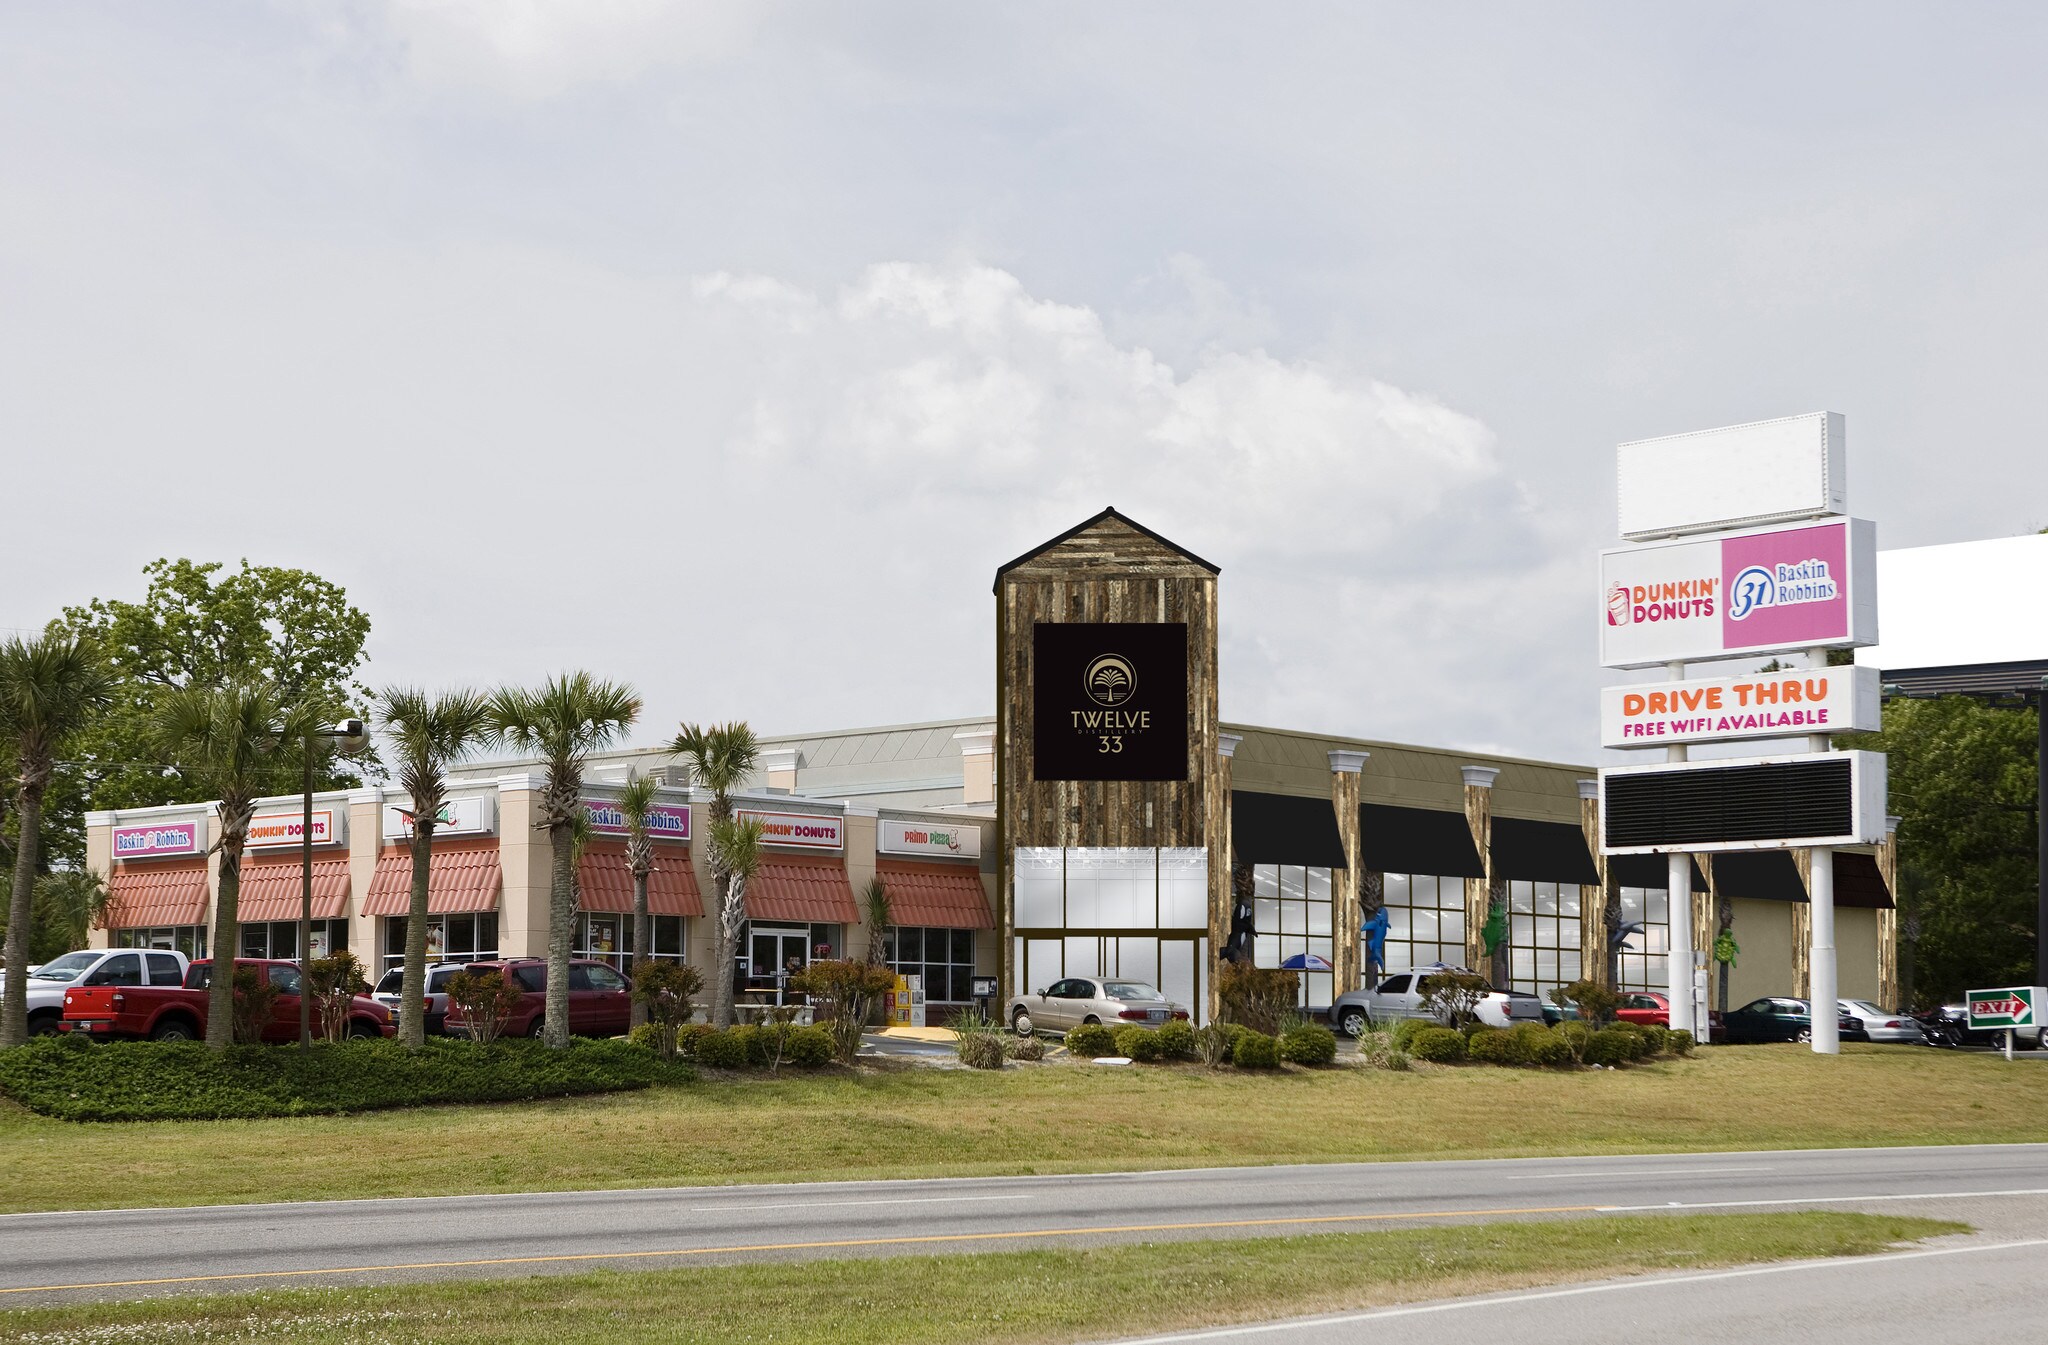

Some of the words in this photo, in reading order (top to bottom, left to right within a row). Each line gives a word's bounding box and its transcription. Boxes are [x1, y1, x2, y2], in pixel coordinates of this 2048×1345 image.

[1779, 562, 1825, 582] Baskin
[1633, 578, 1719, 604] DUNKIN'
[1732, 580, 1768, 617] 31
[1779, 582, 1834, 602] Robbins
[1633, 598, 1714, 623] DONUTS
[1623, 687, 1723, 716] DRIVE
[1732, 678, 1828, 707] THRU
[1071, 711, 1150, 728] TWELVE
[1624, 722, 1665, 737] FREE
[1670, 717, 1712, 734] WIFI
[1717, 709, 1828, 731] AVAILABLE
[1098, 736, 1123, 753] 33
[118, 833, 145, 850] Baskin
[156, 830, 187, 847] Robbins
[250, 825, 287, 838] DUNKIN'
[287, 822, 325, 836] DOTS
[795, 825, 836, 839] DONUTS
[1974, 1001, 2019, 1014] EXIT
